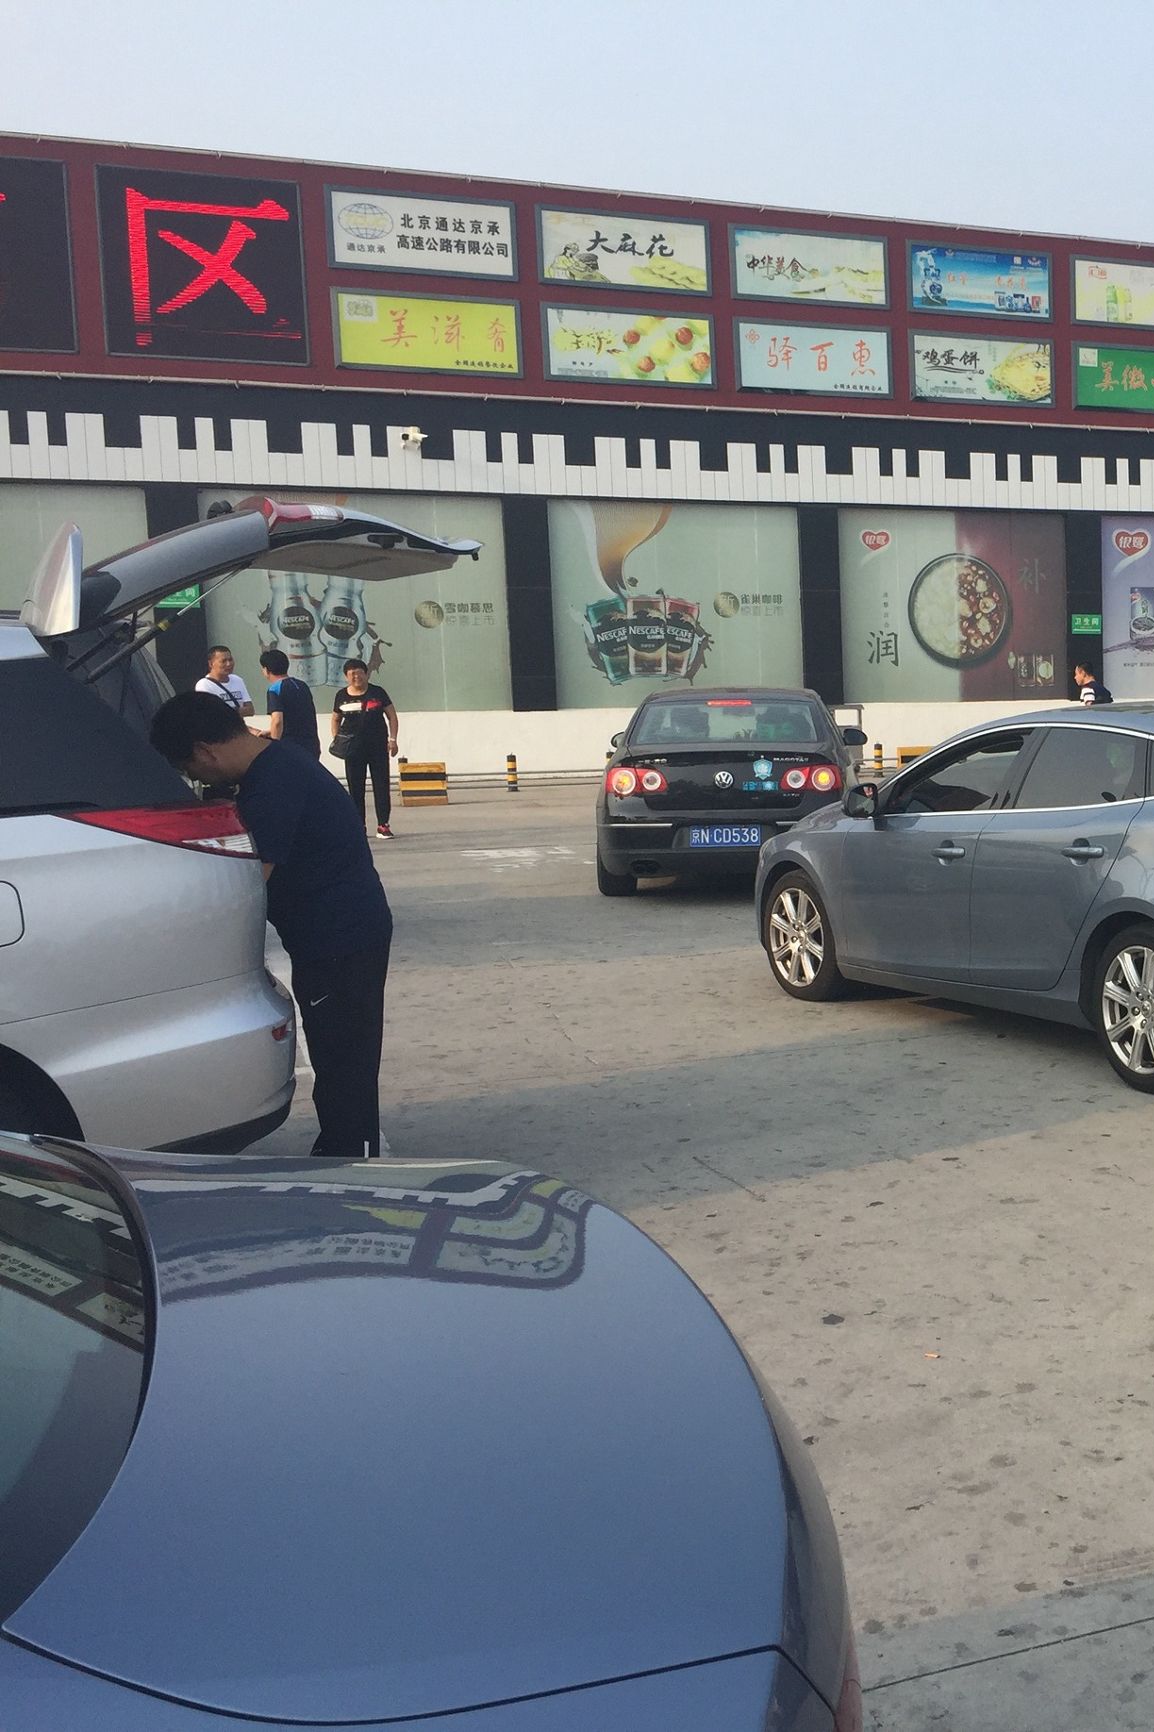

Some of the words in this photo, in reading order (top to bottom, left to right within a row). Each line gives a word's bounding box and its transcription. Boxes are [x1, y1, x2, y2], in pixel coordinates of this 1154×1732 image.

[400, 213, 501, 236] 北京通达京承
[397, 234, 509, 257] 高速公路有限公司
[585, 230, 675, 259] 大麻花
[125, 187, 290, 346] 区
[923, 348, 980, 370] 鸡蛋饼
[596, 627, 628, 642] NESCAF
[867, 631, 899, 667] 润
